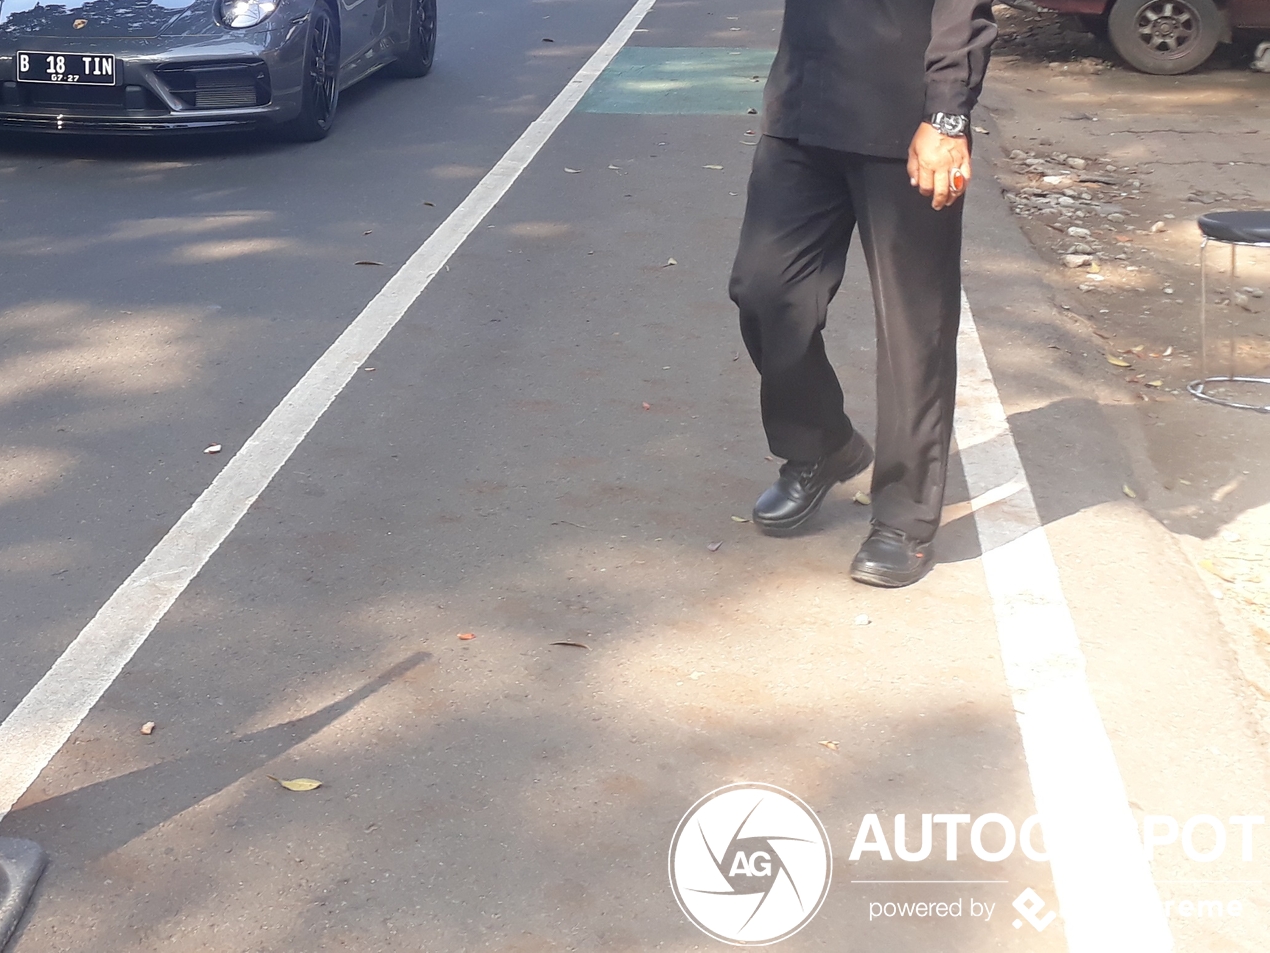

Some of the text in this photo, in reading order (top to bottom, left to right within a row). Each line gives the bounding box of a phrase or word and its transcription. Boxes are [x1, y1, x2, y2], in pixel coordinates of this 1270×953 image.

[20, 54, 112, 76] B 18 TIN
